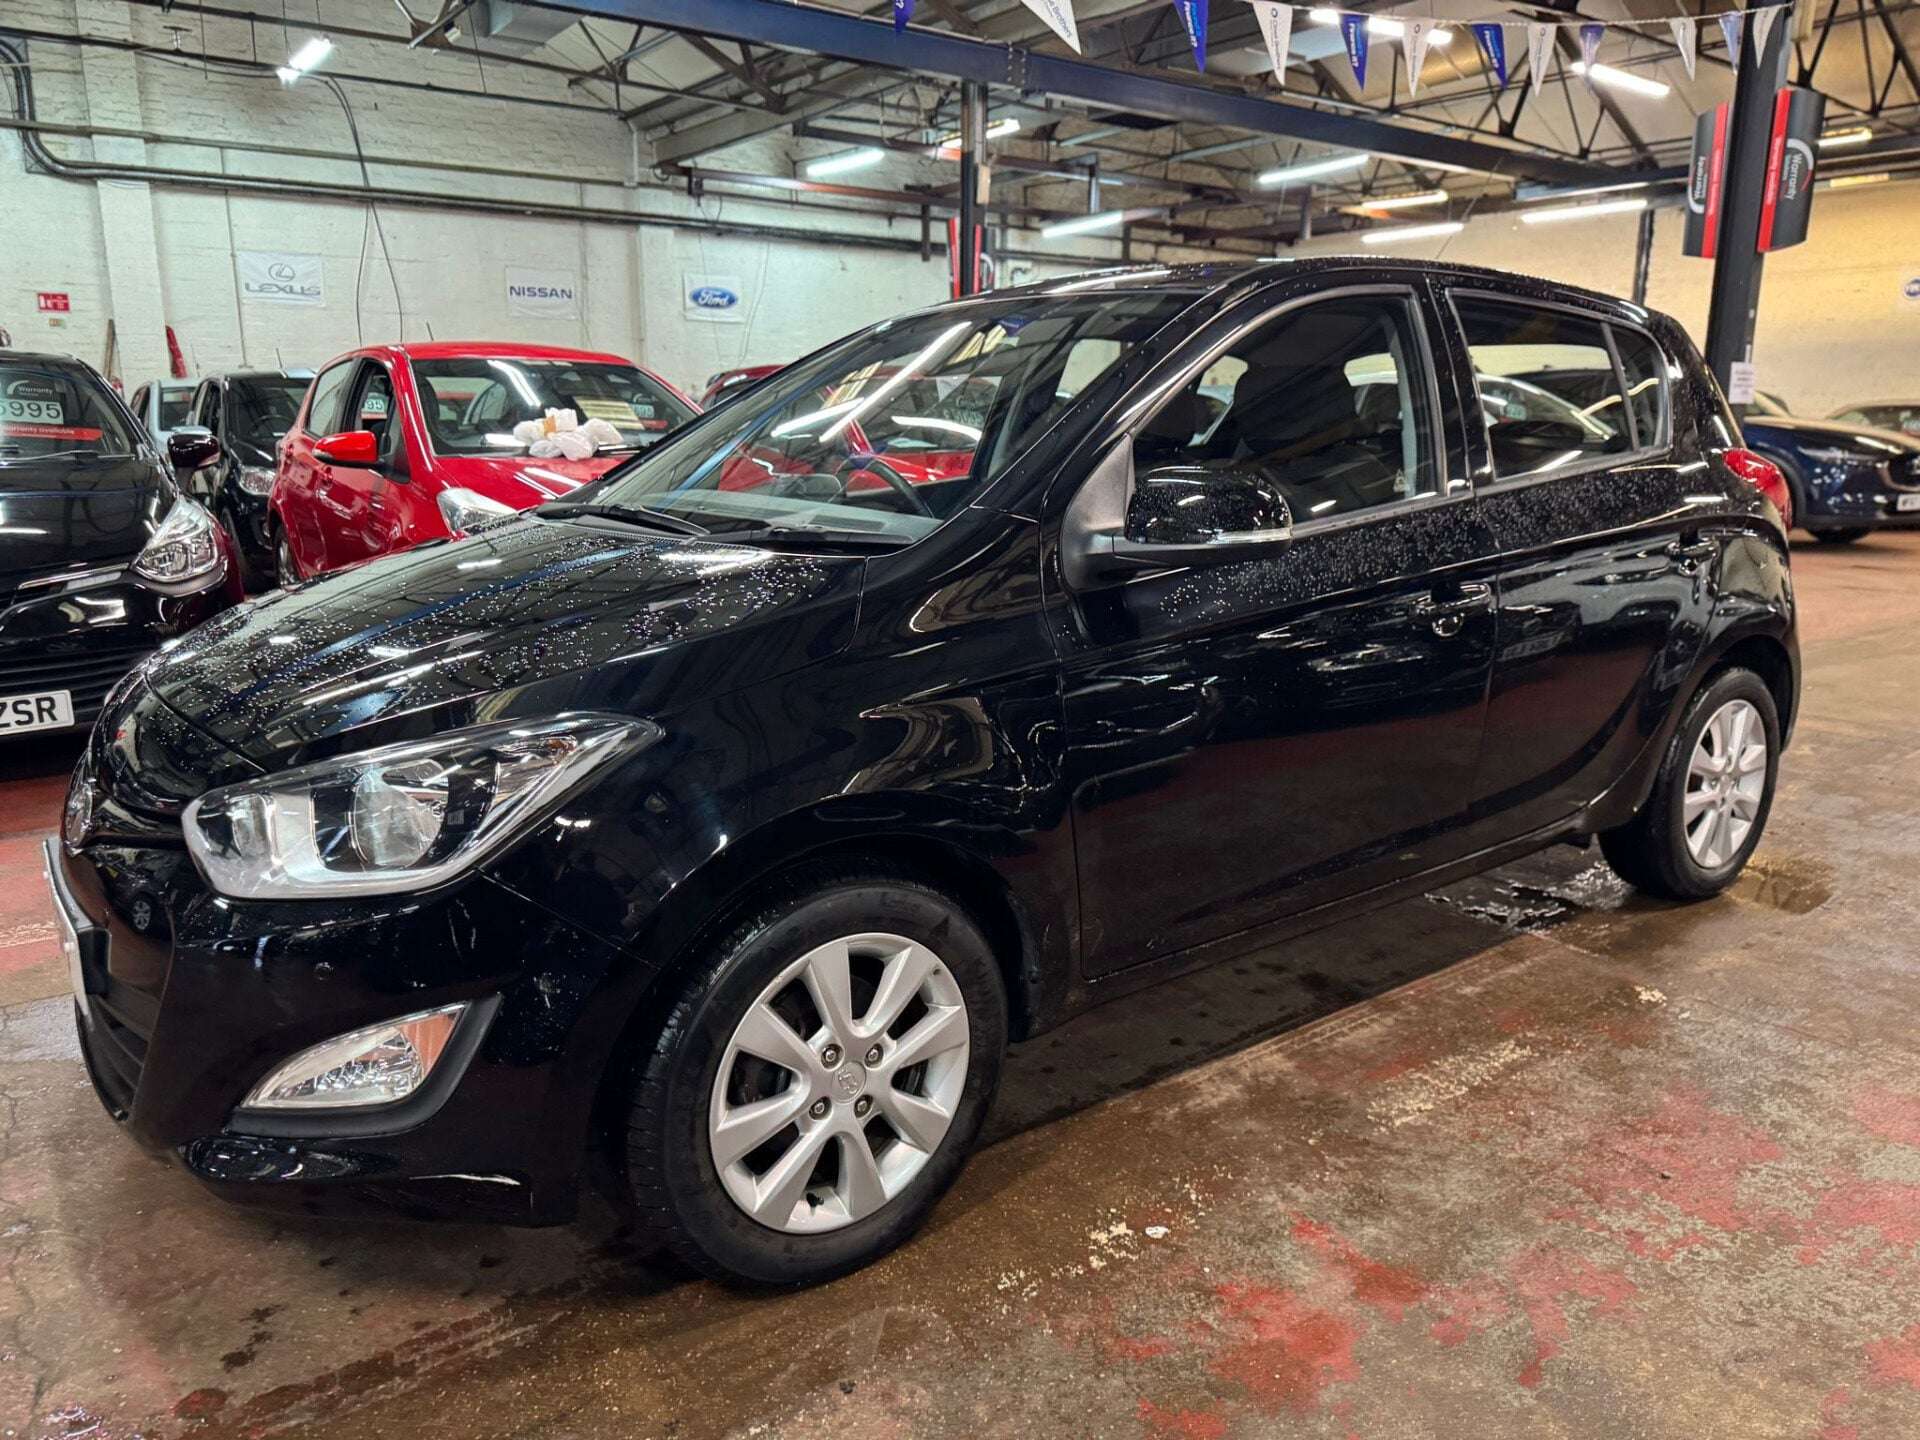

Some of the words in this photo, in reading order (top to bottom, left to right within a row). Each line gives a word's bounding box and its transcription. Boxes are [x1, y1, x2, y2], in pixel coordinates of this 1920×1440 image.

[1052, 6, 1072, 38] Brothers
[1785, 153, 1802, 200] Warranty
[244, 282, 321, 296] LEXUS
[509, 285, 573, 299] NISSAN
[698, 289, 730, 306] Ford
[18, 386, 53, 395] Warranty
